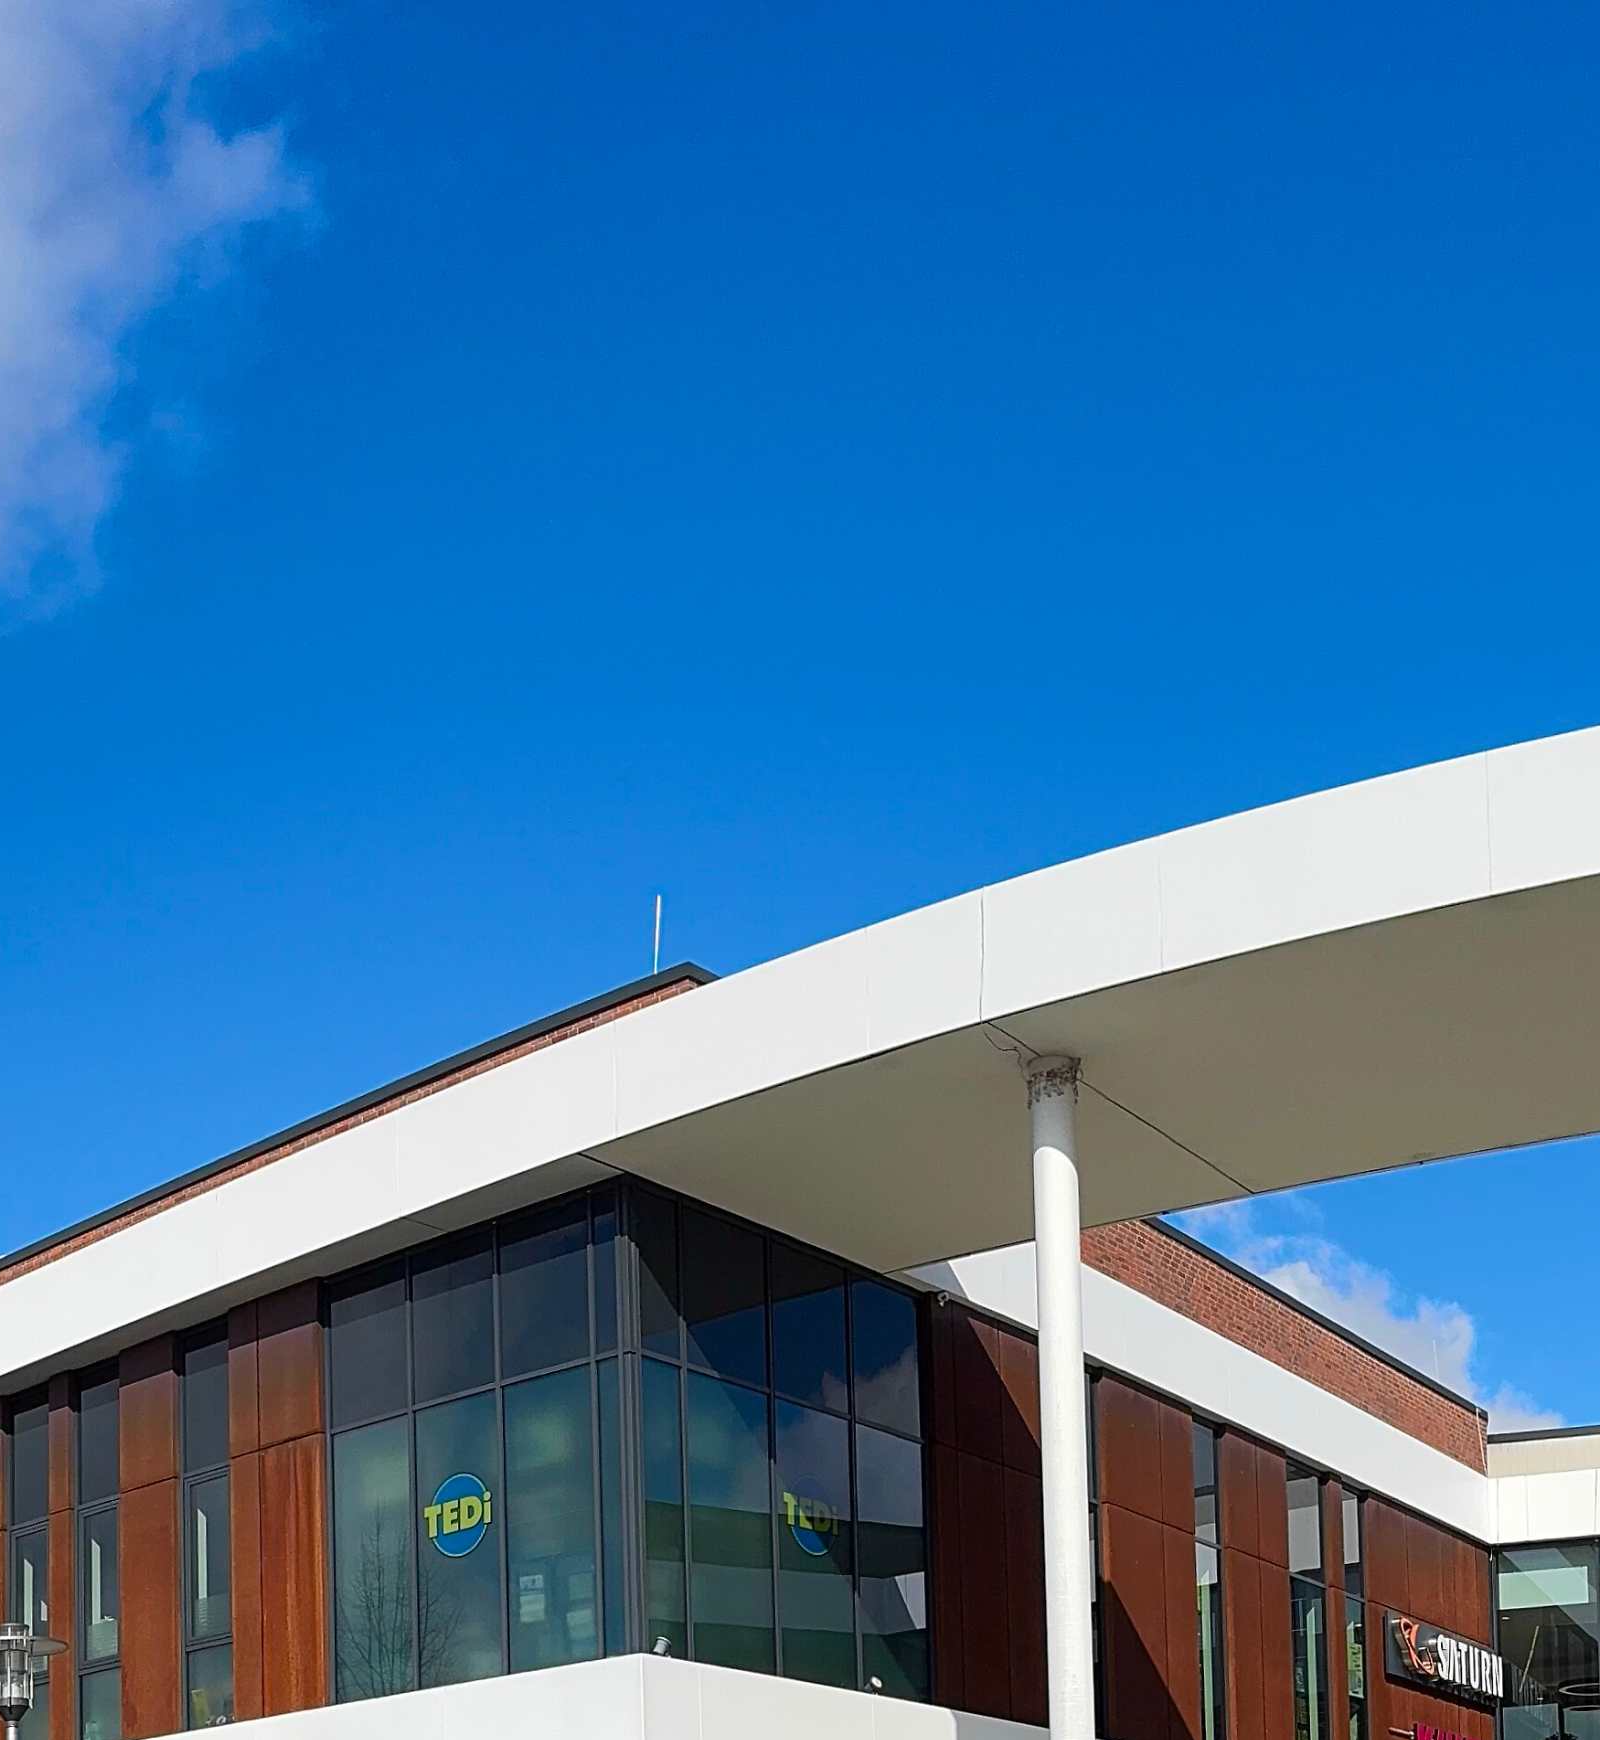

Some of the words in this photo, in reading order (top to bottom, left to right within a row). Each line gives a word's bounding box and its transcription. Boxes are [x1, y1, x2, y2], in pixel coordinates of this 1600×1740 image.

[423, 1491, 492, 1538] TEDi
[783, 1491, 839, 1536] TEDi
[1437, 1634, 1503, 1698] SATURN
